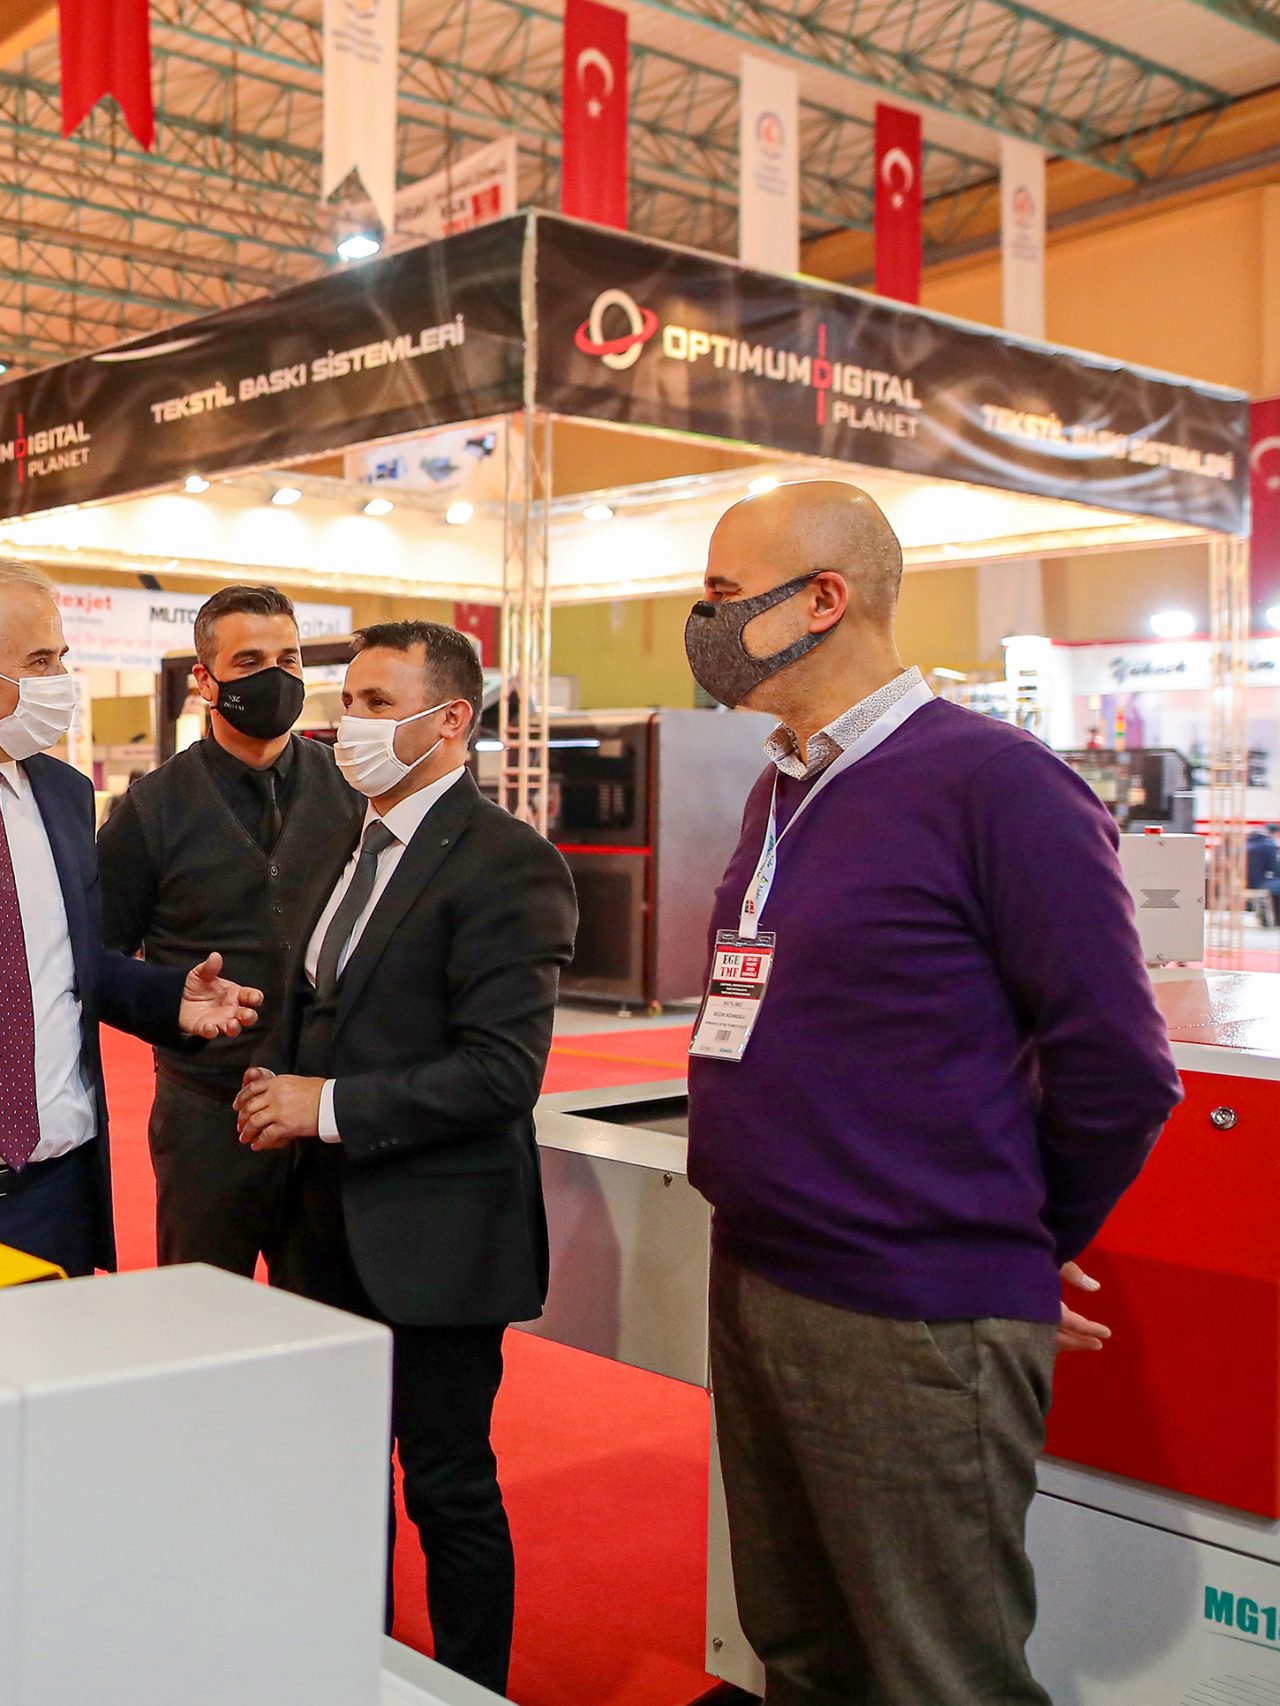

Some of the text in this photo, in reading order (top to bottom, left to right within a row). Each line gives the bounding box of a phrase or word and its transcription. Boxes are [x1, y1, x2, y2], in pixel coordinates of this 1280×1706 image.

[151, 313, 465, 424] TEKSTİL BASKI SİSTEMLERİ
[831, 401, 920, 438] PLANET
[27, 447, 90, 478] PLANET
[720, 966, 739, 978] TMF
[722, 954, 740, 966] EGE
[1204, 1585, 1280, 1641] MG1
